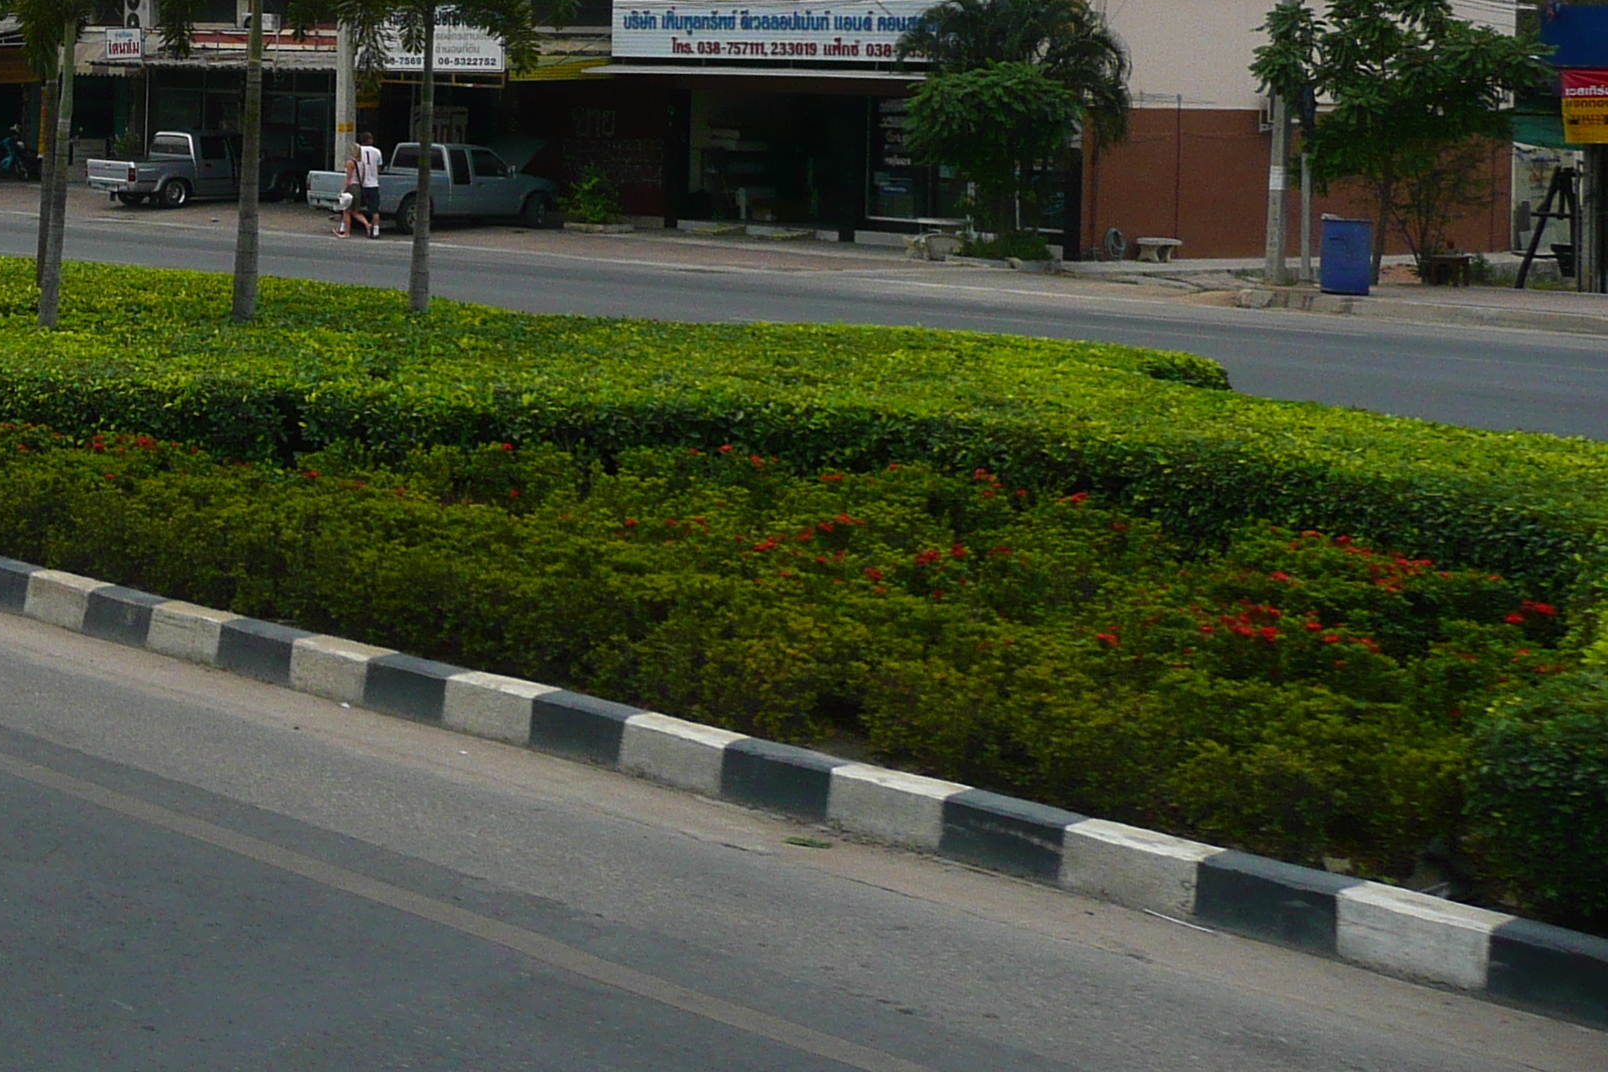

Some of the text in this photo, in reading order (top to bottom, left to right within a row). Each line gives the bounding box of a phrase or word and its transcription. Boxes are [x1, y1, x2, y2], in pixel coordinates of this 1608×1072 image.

[623, 9, 657, 30] บริษัท
[671, 36, 694, 53] โทร.
[770, 42, 817, 56] 233019
[438, 57, 497, 66] 06-5322752
